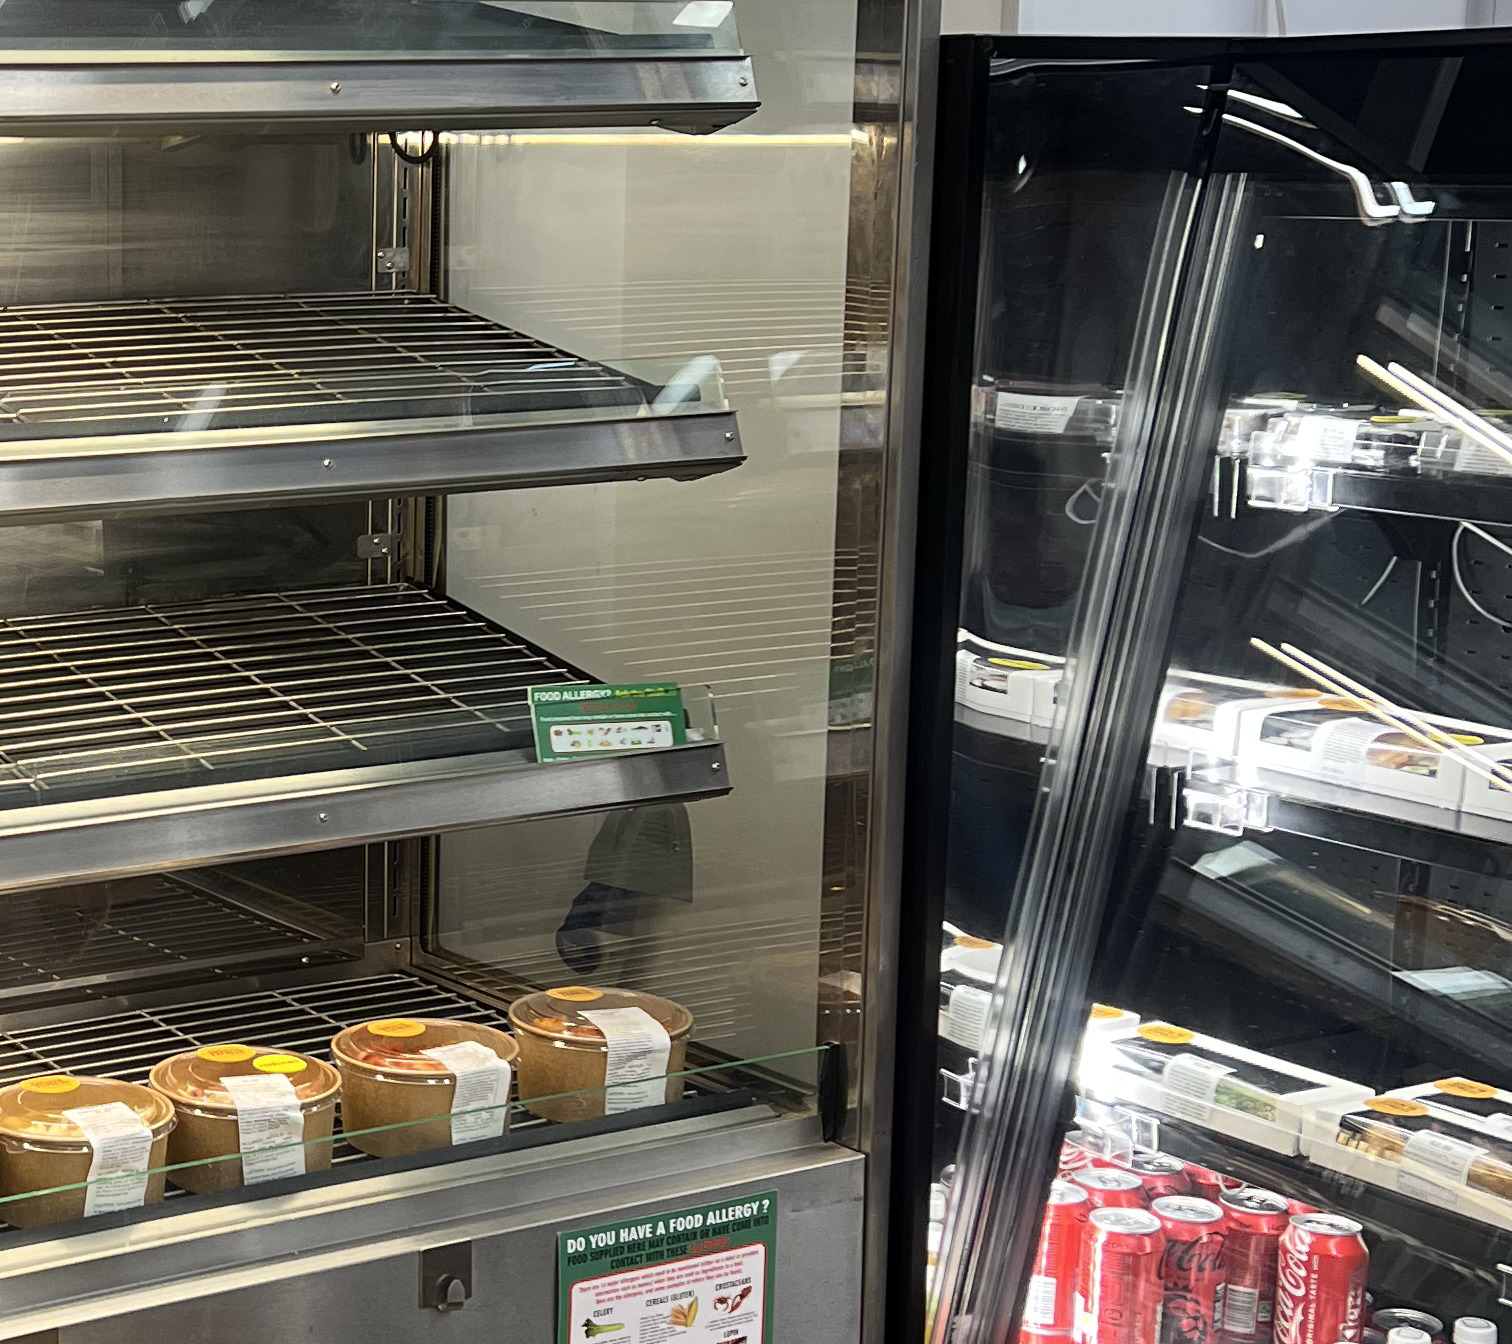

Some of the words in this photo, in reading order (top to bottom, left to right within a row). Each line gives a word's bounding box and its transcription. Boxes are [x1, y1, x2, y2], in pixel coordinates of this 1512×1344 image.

[534, 690, 562, 702] FOOD
[567, 1236, 586, 1254] DO
[589, 1230, 616, 1249] YOU
[619, 1223, 653, 1243] HAVE
[655, 1221, 666, 1236] A
[669, 1213, 704, 1233] FOOD
[706, 1201, 760, 1226] ALLERGY
[568, 1253, 587, 1266] FOOD
[590, 1245, 625, 1261] SUPPLIED
[628, 1240, 647, 1254] HERE
[649, 1236, 665, 1249] MAY
[611, 1253, 644, 1270] CONTACT
[1308, 1273, 1319, 1301] TASTE
[593, 1307, 614, 1318] CELERY
[1305, 1303, 1317, 1344] ORIGINAL
